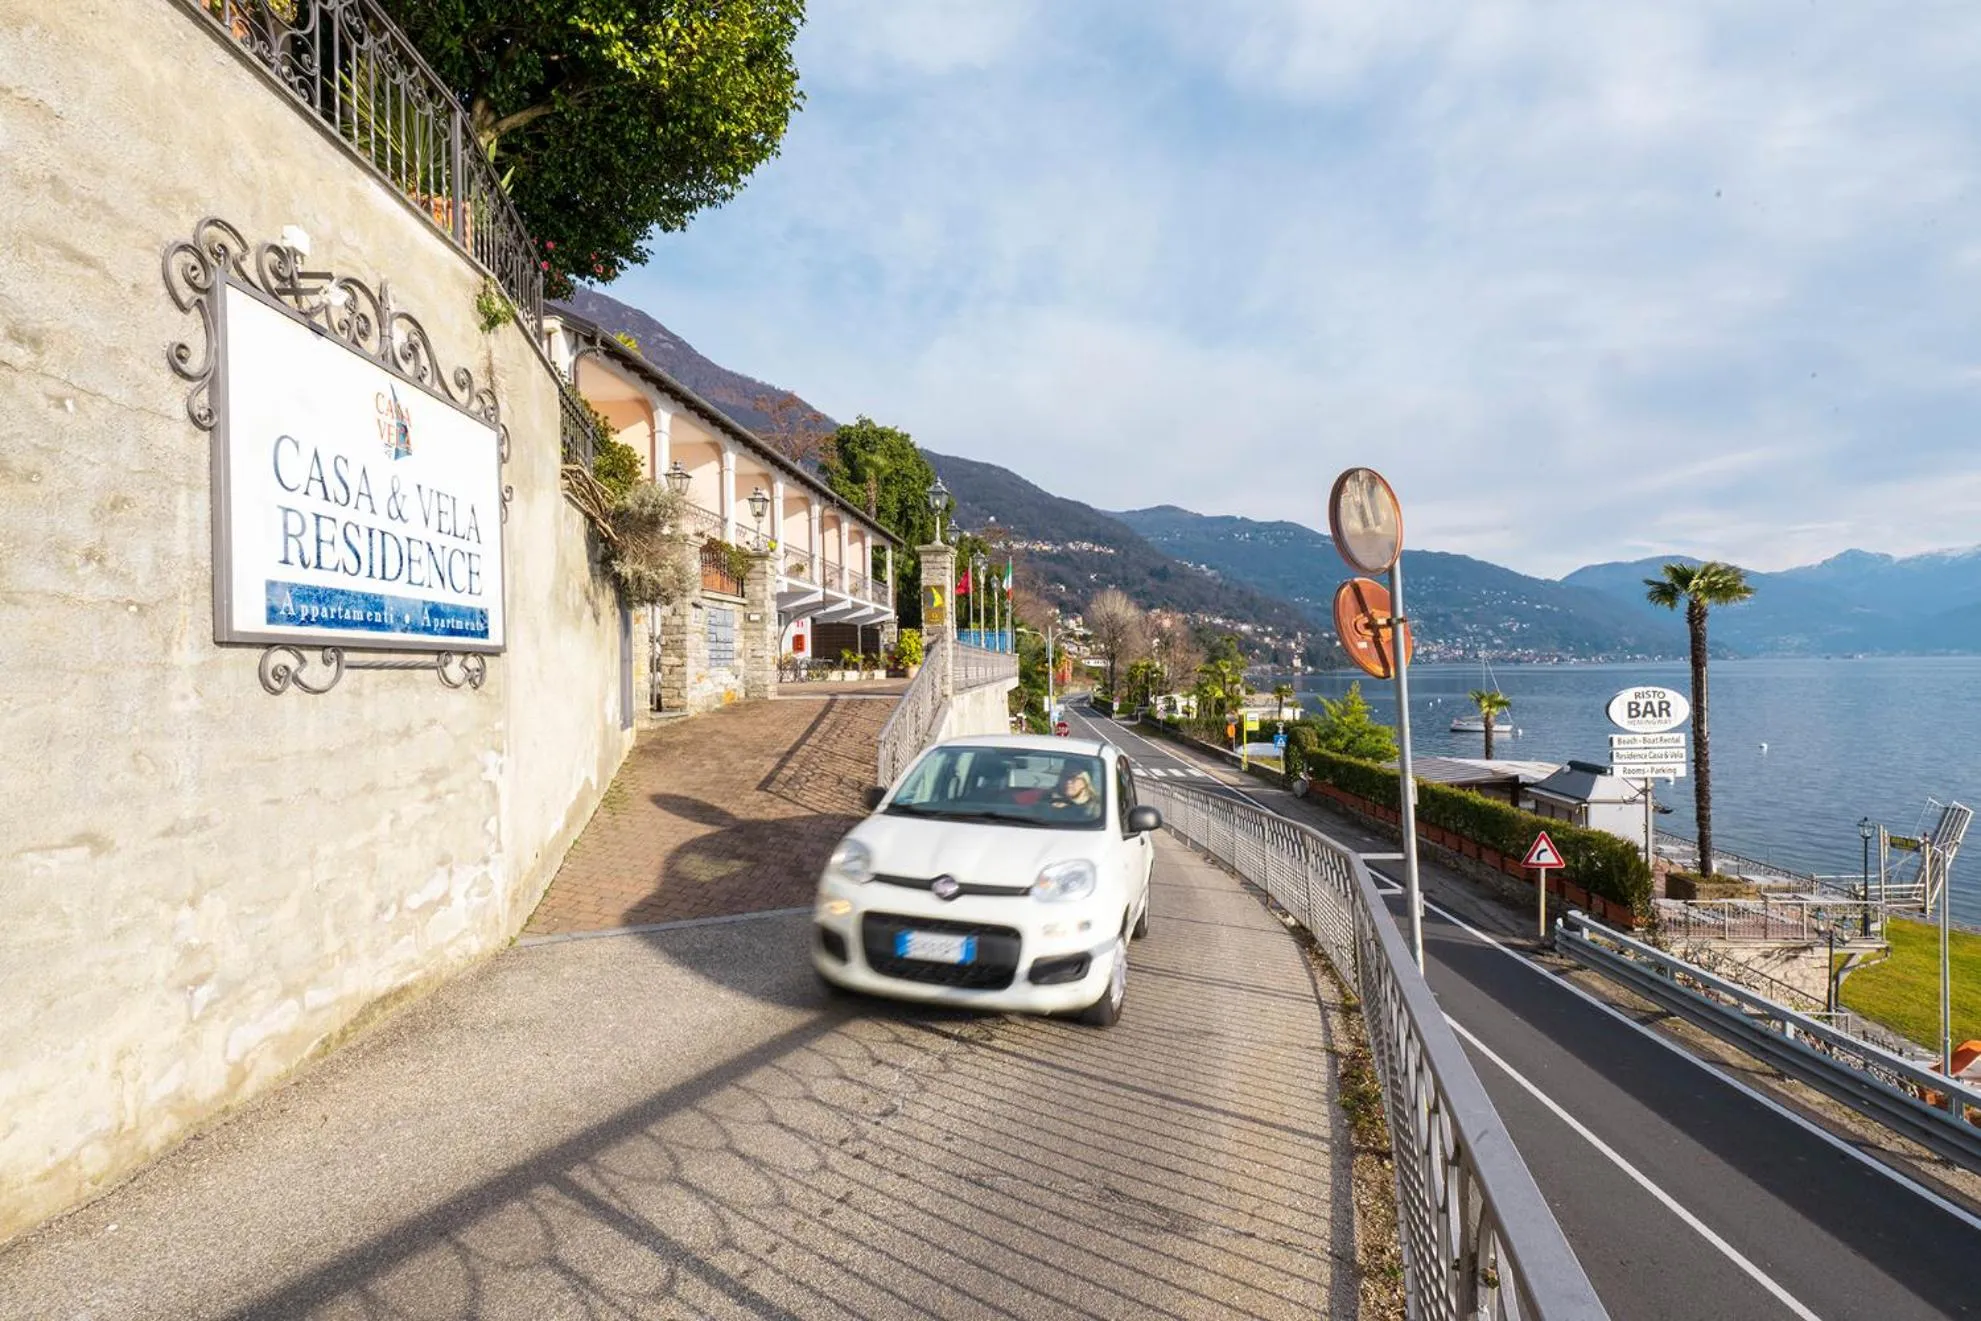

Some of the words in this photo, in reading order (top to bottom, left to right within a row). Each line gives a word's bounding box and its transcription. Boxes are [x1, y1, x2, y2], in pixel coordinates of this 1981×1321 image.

[273, 434, 377, 515] CASA
[387, 475, 409, 524] &
[416, 484, 482, 545] VELA
[276, 504, 483, 597] RESIDENCE
[279, 591, 395, 625] Appartamenti
[421, 606, 485, 632] Apartments
[1634, 690, 1666, 700] RISTO
[1627, 700, 1672, 719] BAR
[1617, 736, 1637, 745] Beach
[1642, 735, 1659, 745] Boat
[1659, 734, 1681, 744] Rental
[1615, 751, 1647, 760] Residence
[1648, 750, 1664, 760] Casa
[1622, 766, 1646, 775] Rooms
[1650, 765, 1677, 776] Parking
